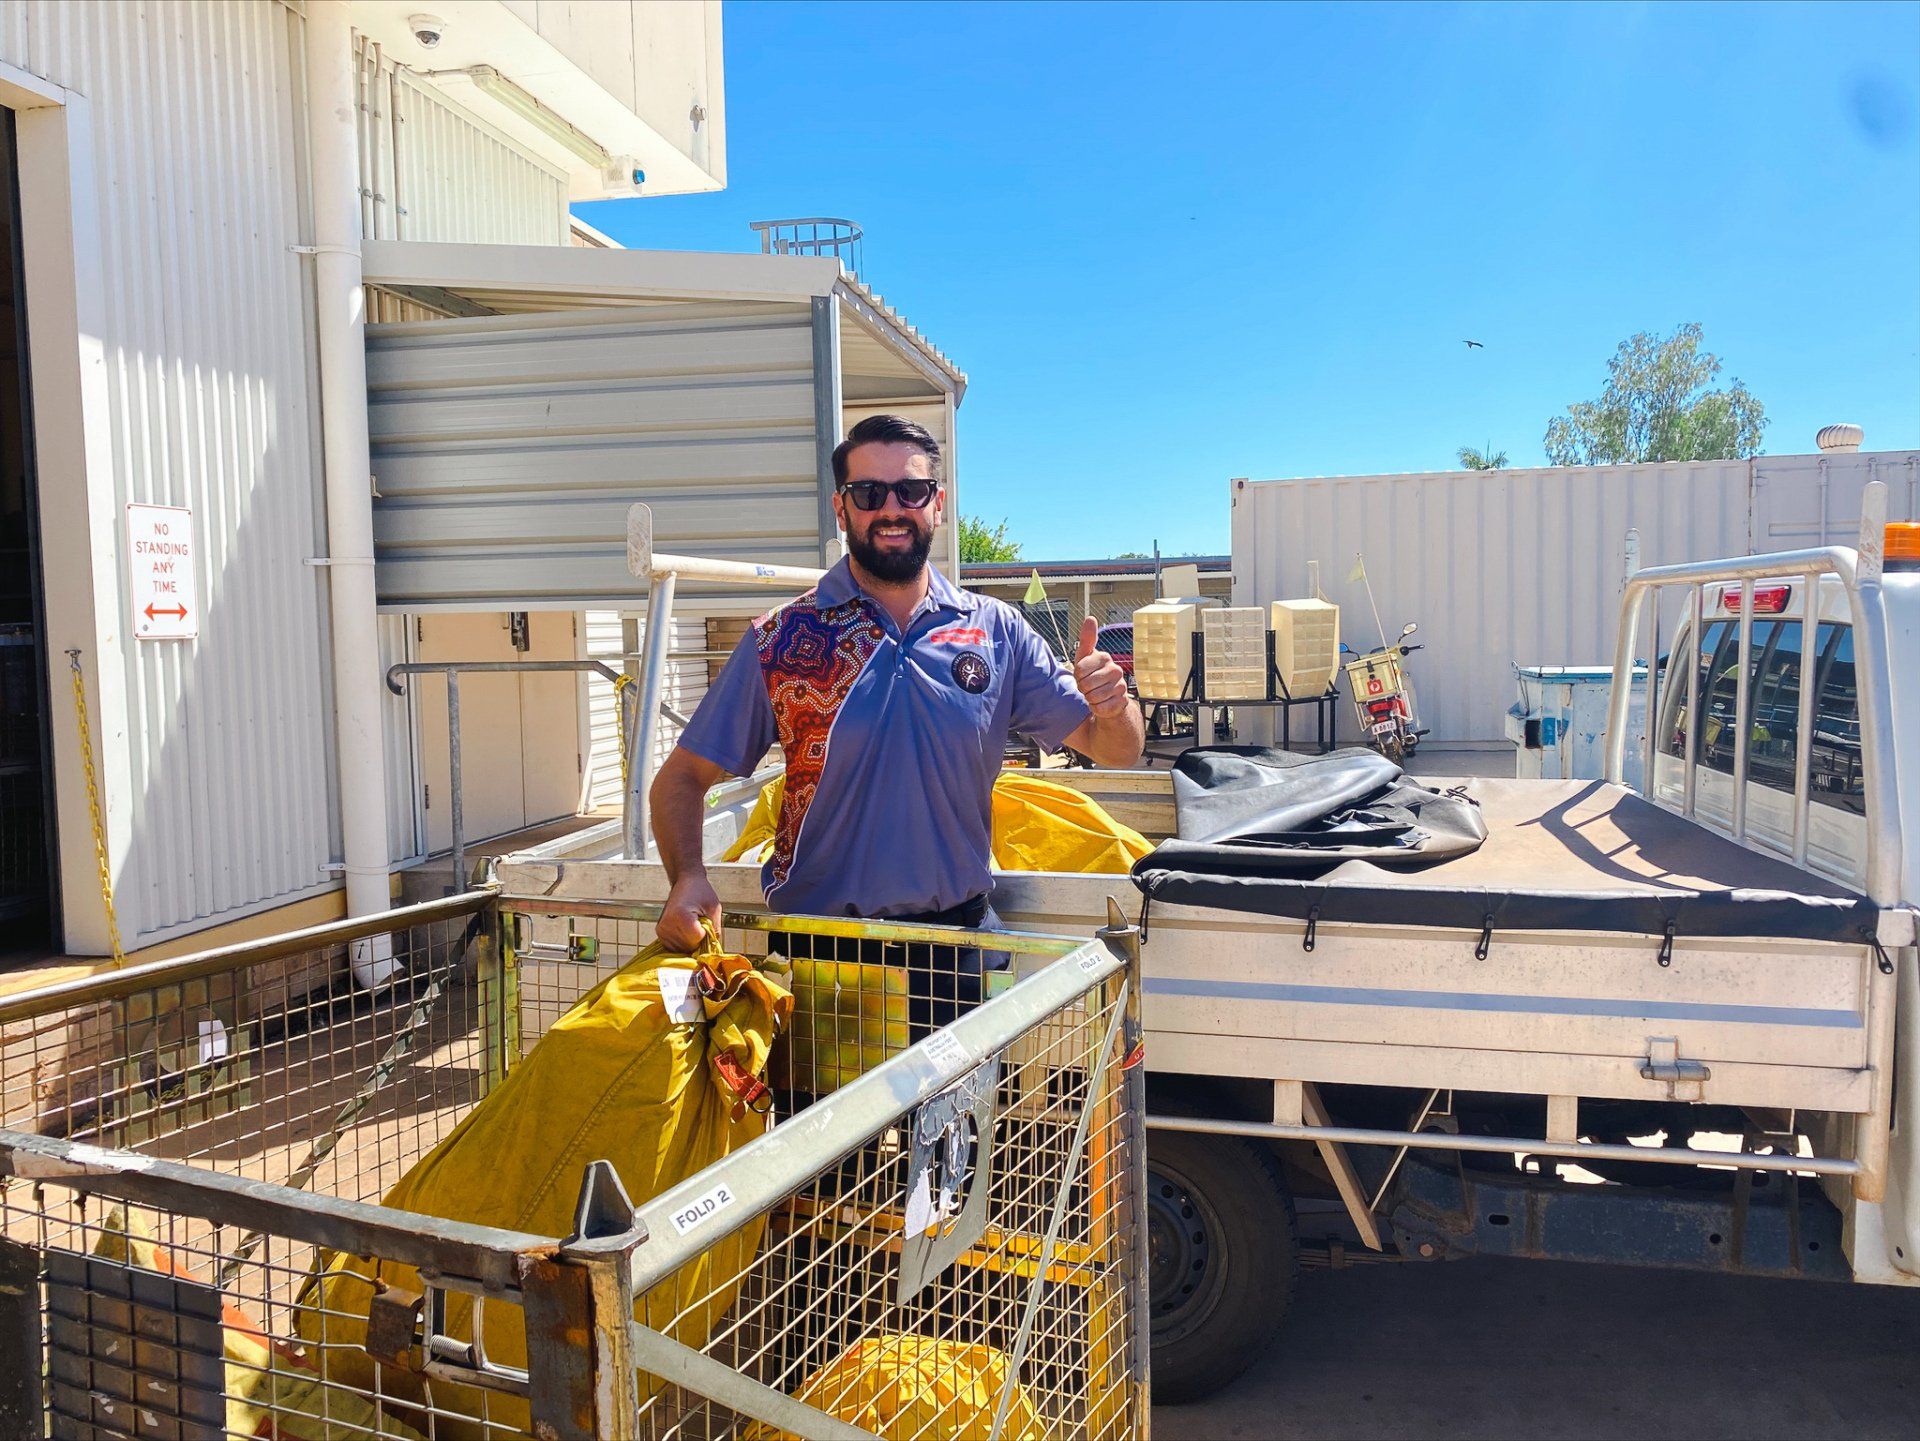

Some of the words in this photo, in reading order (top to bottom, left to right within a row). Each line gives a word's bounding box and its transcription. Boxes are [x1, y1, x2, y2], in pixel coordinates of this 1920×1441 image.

[154, 523, 169, 535] NO
[136, 541, 188, 555] STANDING
[153, 562, 175, 573] ANY
[153, 581, 177, 593] TIME
[1081, 958, 1096, 969] FOLD
[1095, 954, 1102, 962] 2
[676, 1199, 716, 1229] FOLD
[717, 1190, 731, 1203] 2
